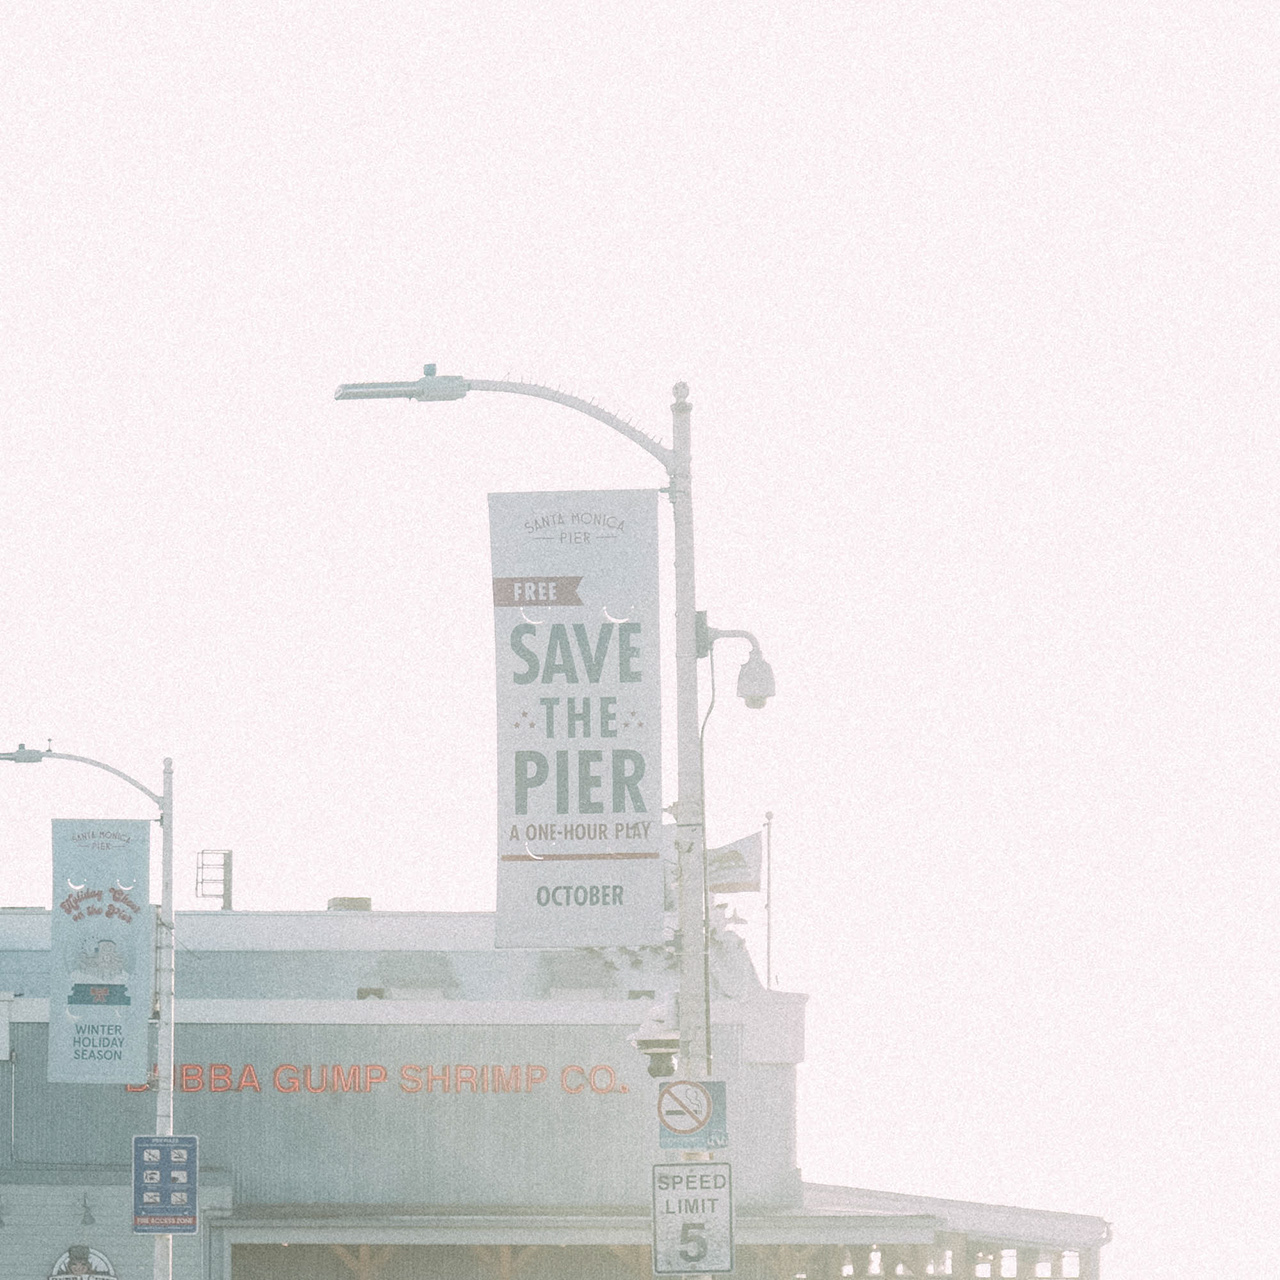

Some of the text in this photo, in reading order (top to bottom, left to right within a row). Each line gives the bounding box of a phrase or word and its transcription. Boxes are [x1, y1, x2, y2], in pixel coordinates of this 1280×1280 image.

[524, 512, 625, 534] SANTA MONICA
[560, 532, 591, 544] PIER
[514, 582, 557, 601] FREE
[510, 622, 642, 686] SAVE
[541, 697, 617, 738] THE
[515, 750, 647, 815] PIER
[72, 831, 131, 844] SANTA MONICA
[509, 822, 652, 841] A ONE-HOUR PLAY
[92, 842, 111, 851] PIER
[536, 885, 624, 906] OCTOBER
[75, 1024, 122, 1035] WINTER
[73, 1036, 125, 1048] HOLIDAY
[73, 1049, 122, 1061] SEASON
[273, 1063, 388, 1094] GUMP
[399, 1064, 547, 1094] SHRIMP
[561, 1064, 630, 1094] CO.
[658, 1174, 726, 1190] SPEED
[665, 1199, 719, 1214] LIMIT
[679, 1222, 708, 1263] 5
